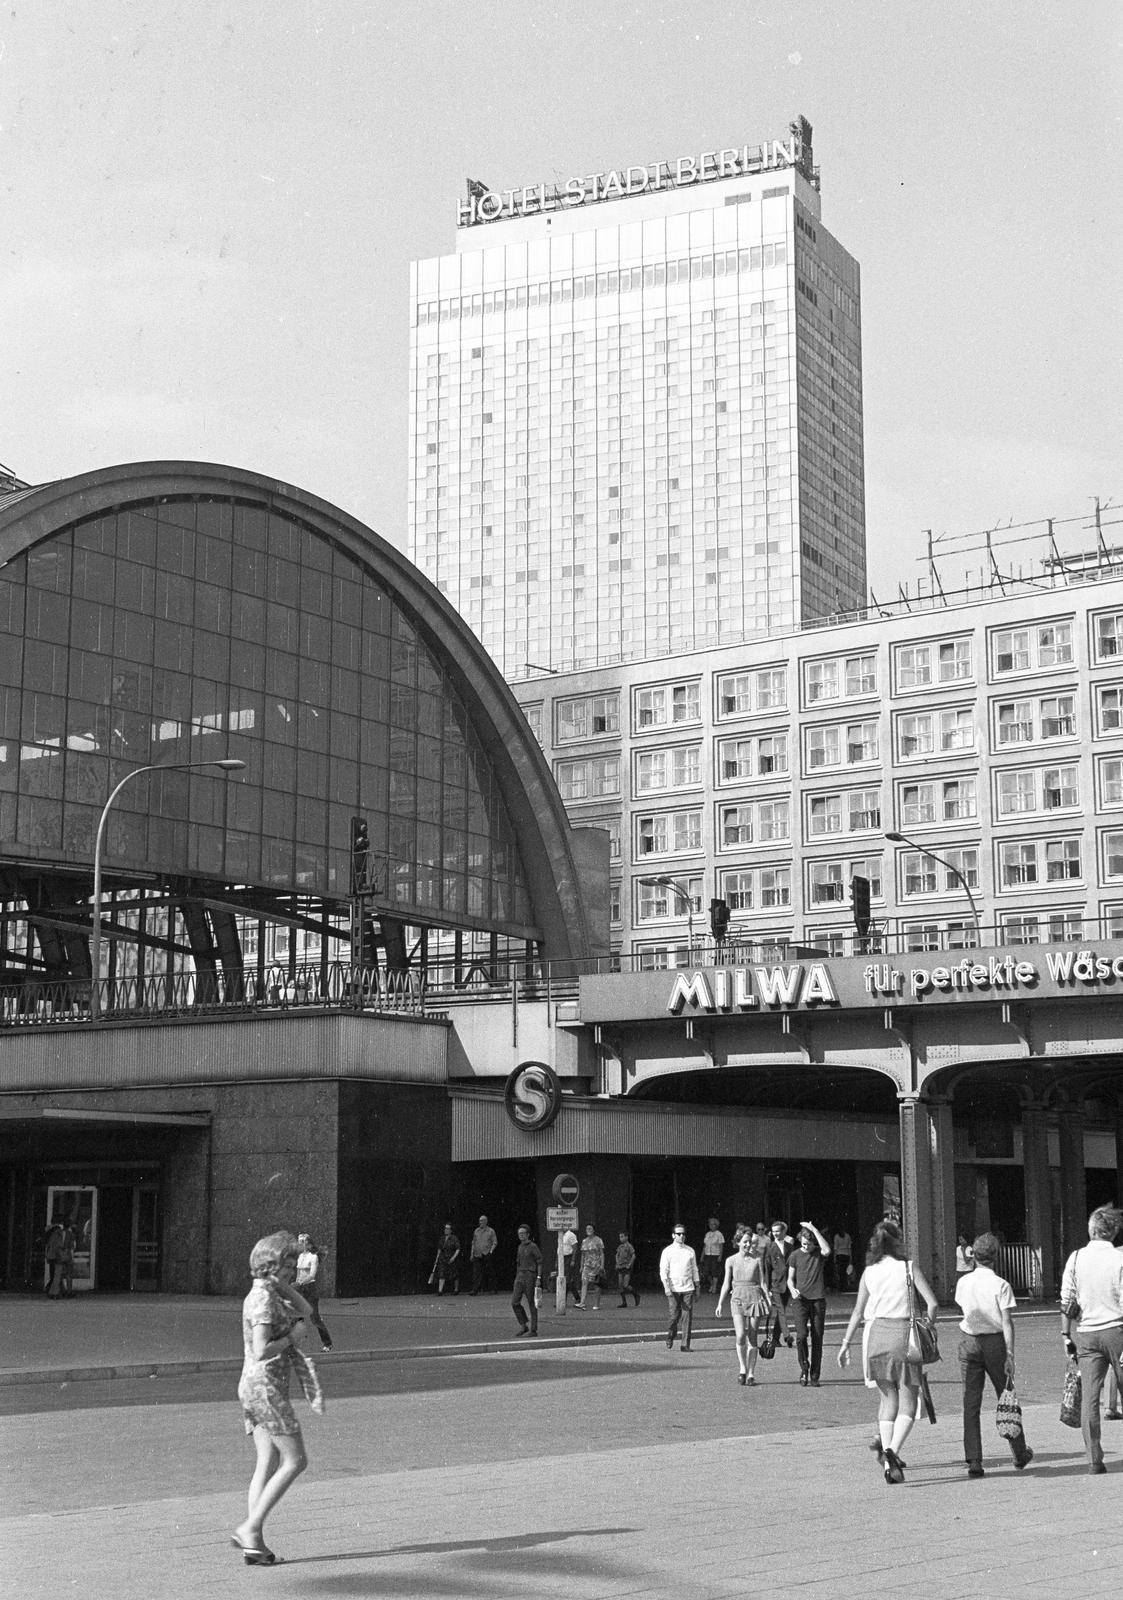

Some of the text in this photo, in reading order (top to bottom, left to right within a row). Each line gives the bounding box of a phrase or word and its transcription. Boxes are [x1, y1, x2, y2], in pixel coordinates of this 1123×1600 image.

[456, 136, 796, 226] HOTEL STADT BERLIN
[666, 963, 837, 1011] MILWA
[863, 963, 900, 993] für
[910, 954, 1035, 997] perfekte
[514, 1068, 548, 1123] S
